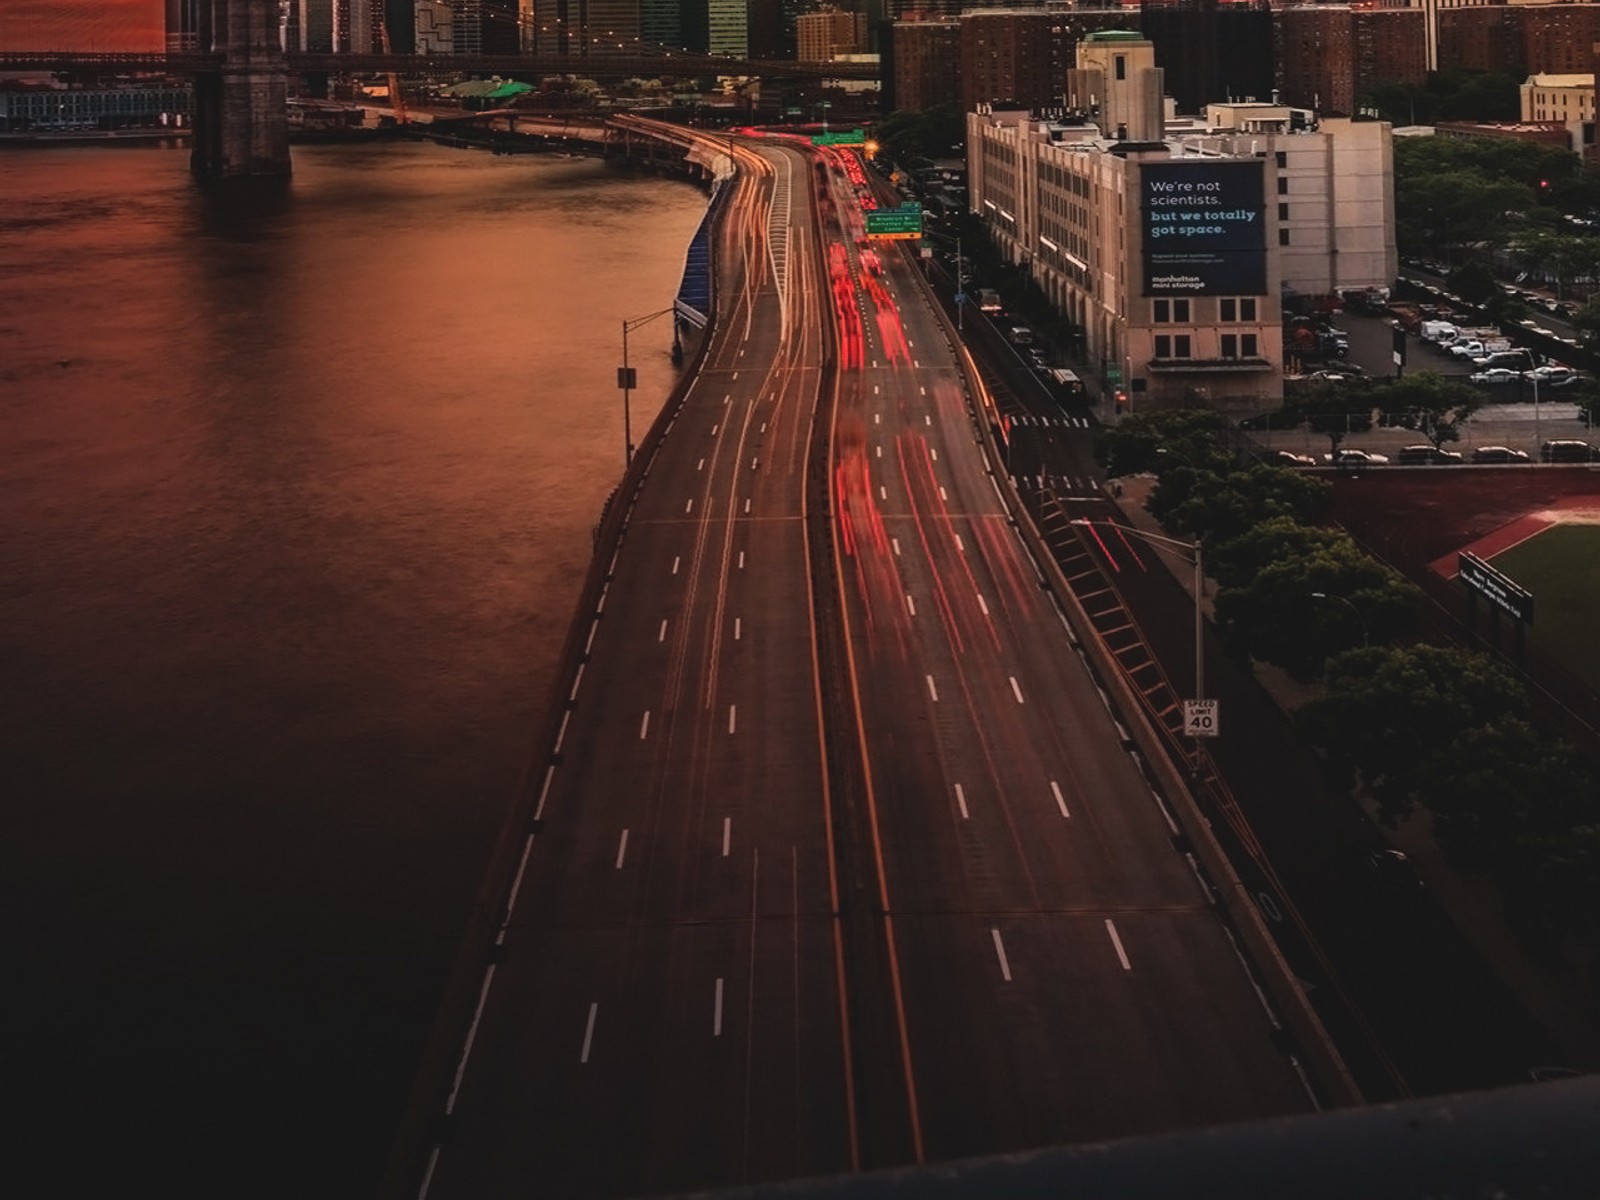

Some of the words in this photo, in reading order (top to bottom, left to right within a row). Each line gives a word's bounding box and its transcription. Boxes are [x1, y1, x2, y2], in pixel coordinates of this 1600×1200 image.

[1150, 181, 1193, 192] We're
[1196, 182, 1221, 191] not
[1151, 195, 1222, 206] scientists.
[1151, 211, 1178, 221] but
[1180, 212, 1202, 220] we
[1204, 209, 1256, 222] totally
[1151, 226, 1176, 238] got
[1179, 225, 1227, 237] space.
[1151, 274, 1200, 283] manhattan
[1172, 281, 1206, 290] storage
[1190, 708, 1211, 716] LIMIT
[1190, 716, 1212, 728] 40
